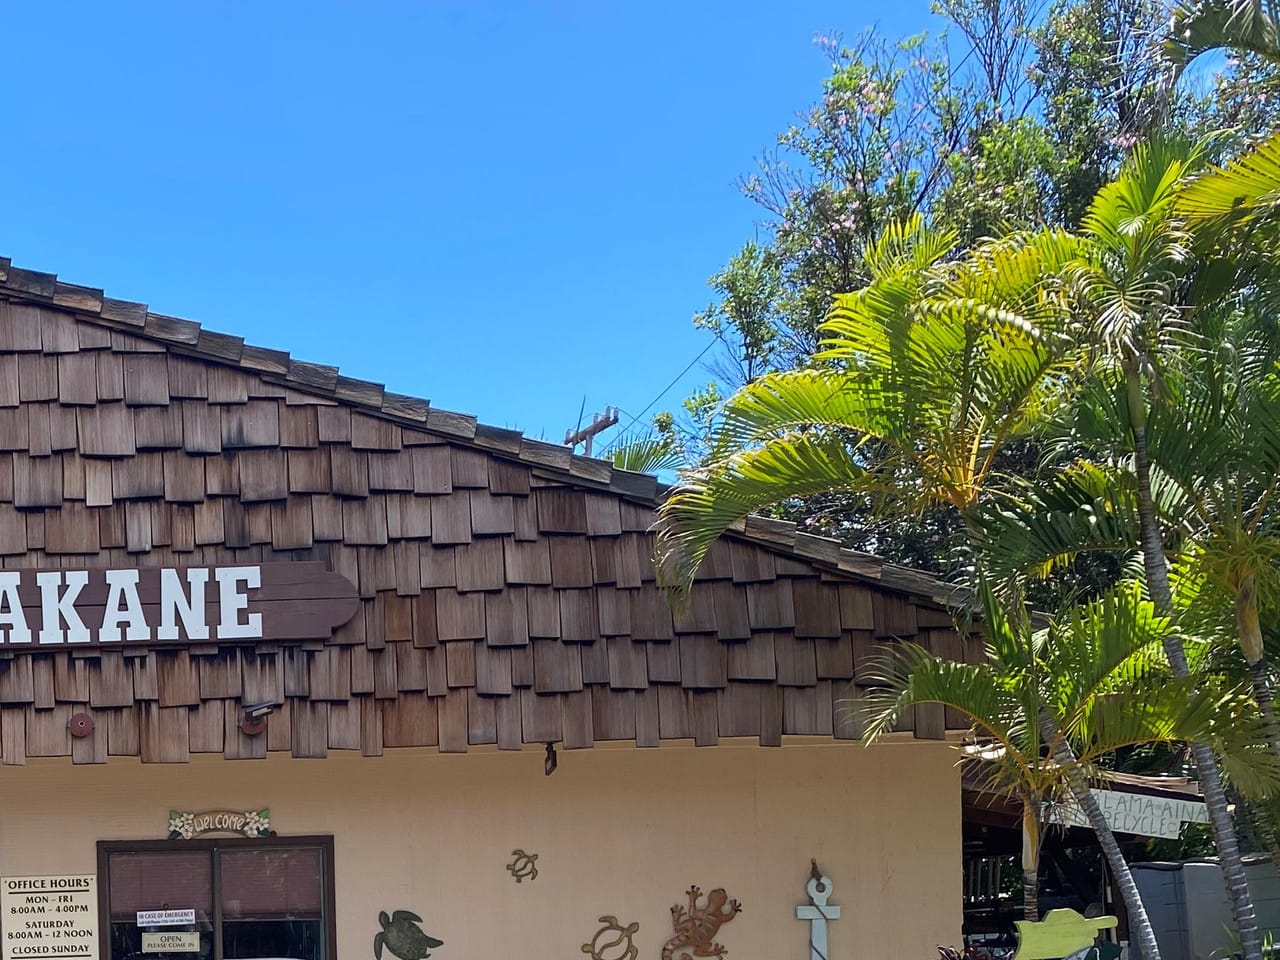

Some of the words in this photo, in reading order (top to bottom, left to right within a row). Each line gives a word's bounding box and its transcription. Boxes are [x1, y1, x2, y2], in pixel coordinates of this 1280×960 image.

[8, 880, 47, 889] OFFICE
[50, 878, 90, 888] HOURS
[25, 896, 49, 904] MON
[58, 895, 73, 903] FRI
[25, 920, 74, 929] SATURDAY
[52, 930, 61, 938] 12
[63, 929, 93, 938] NOON
[160, 935, 182, 943] OPEN
[12, 946, 49, 954] CLOSED
[51, 944, 90, 953] SUNDAY
